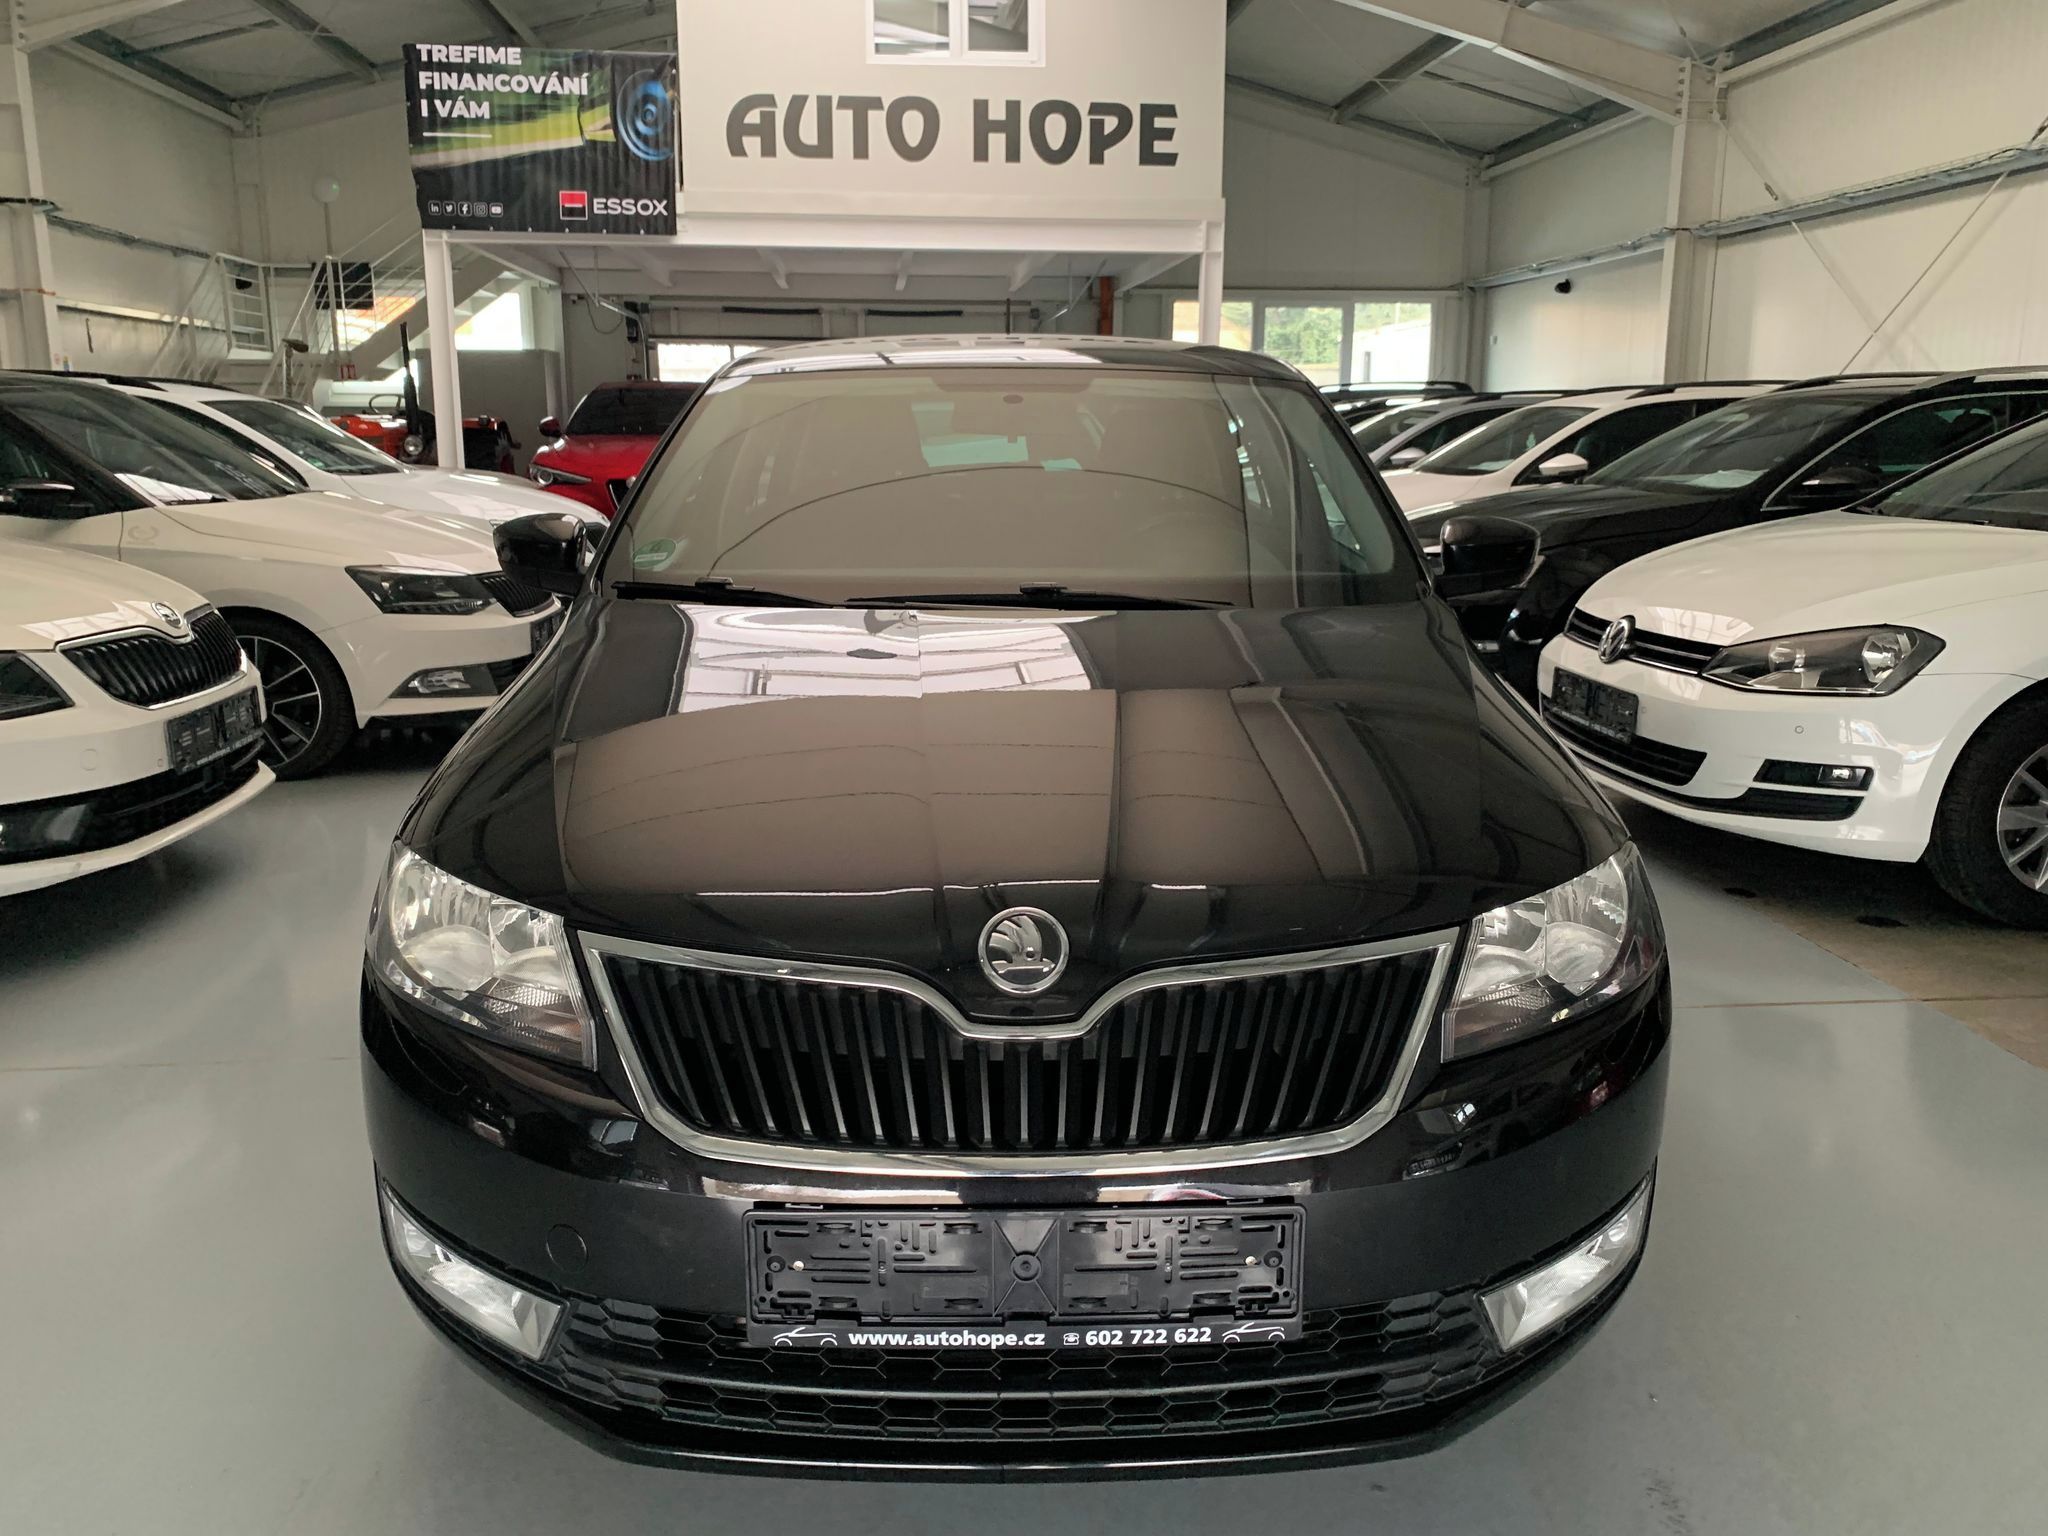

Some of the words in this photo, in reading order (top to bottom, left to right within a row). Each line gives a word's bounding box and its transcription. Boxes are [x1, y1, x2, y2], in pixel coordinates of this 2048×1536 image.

[416, 44, 522, 65] TREFIME
[419, 71, 589, 95] FINANCOVÁNÍ
[420, 99, 429, 118] I
[434, 96, 491, 119] VÁM
[726, 93, 940, 162] AUTO
[972, 98, 1179, 167] HOPE
[592, 198, 668, 216] ESSOX
[848, 1330, 1045, 1349] www.autohope.cz
[1085, 1330, 1123, 1346] 602
[1130, 1329, 1168, 1345] 722
[1174, 1327, 1212, 1343] 622
